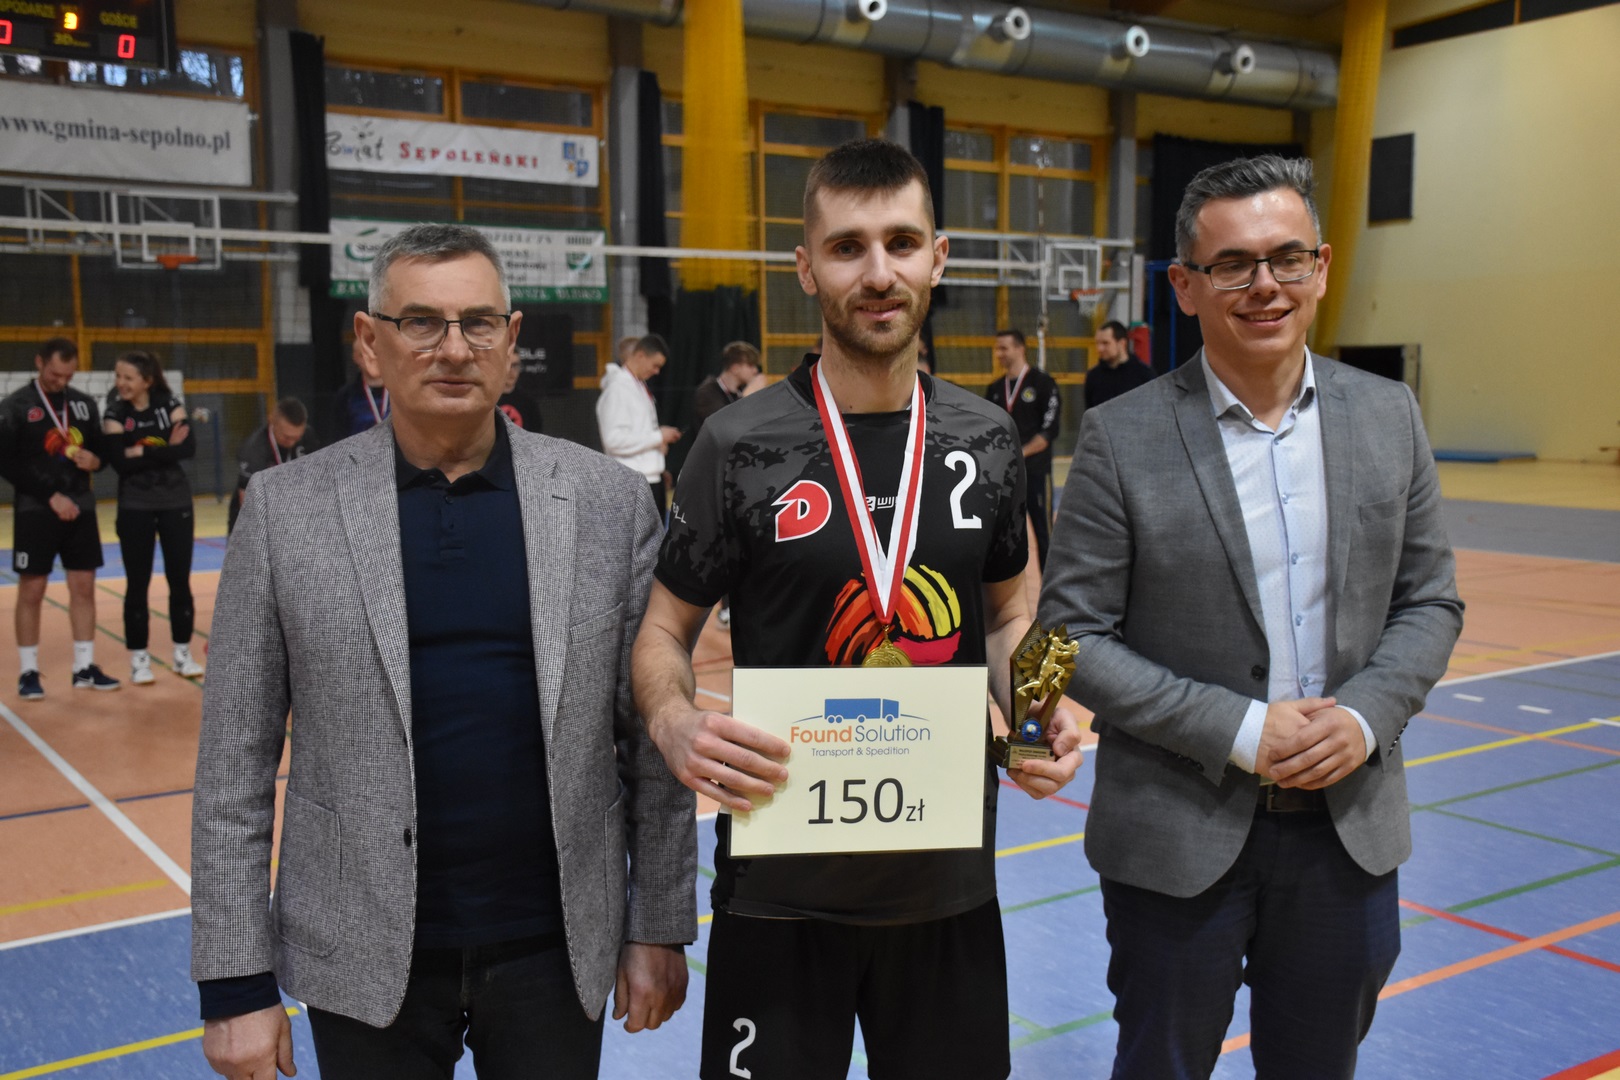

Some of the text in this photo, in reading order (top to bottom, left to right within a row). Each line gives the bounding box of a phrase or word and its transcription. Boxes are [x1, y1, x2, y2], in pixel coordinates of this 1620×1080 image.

[118, 34, 136, 59] 0
[69, 401, 90, 421] 10
[944, 450, 982, 529] 2
[812, 746, 909, 758] Transport & Spedition
[729, 1017, 757, 1080] 2
